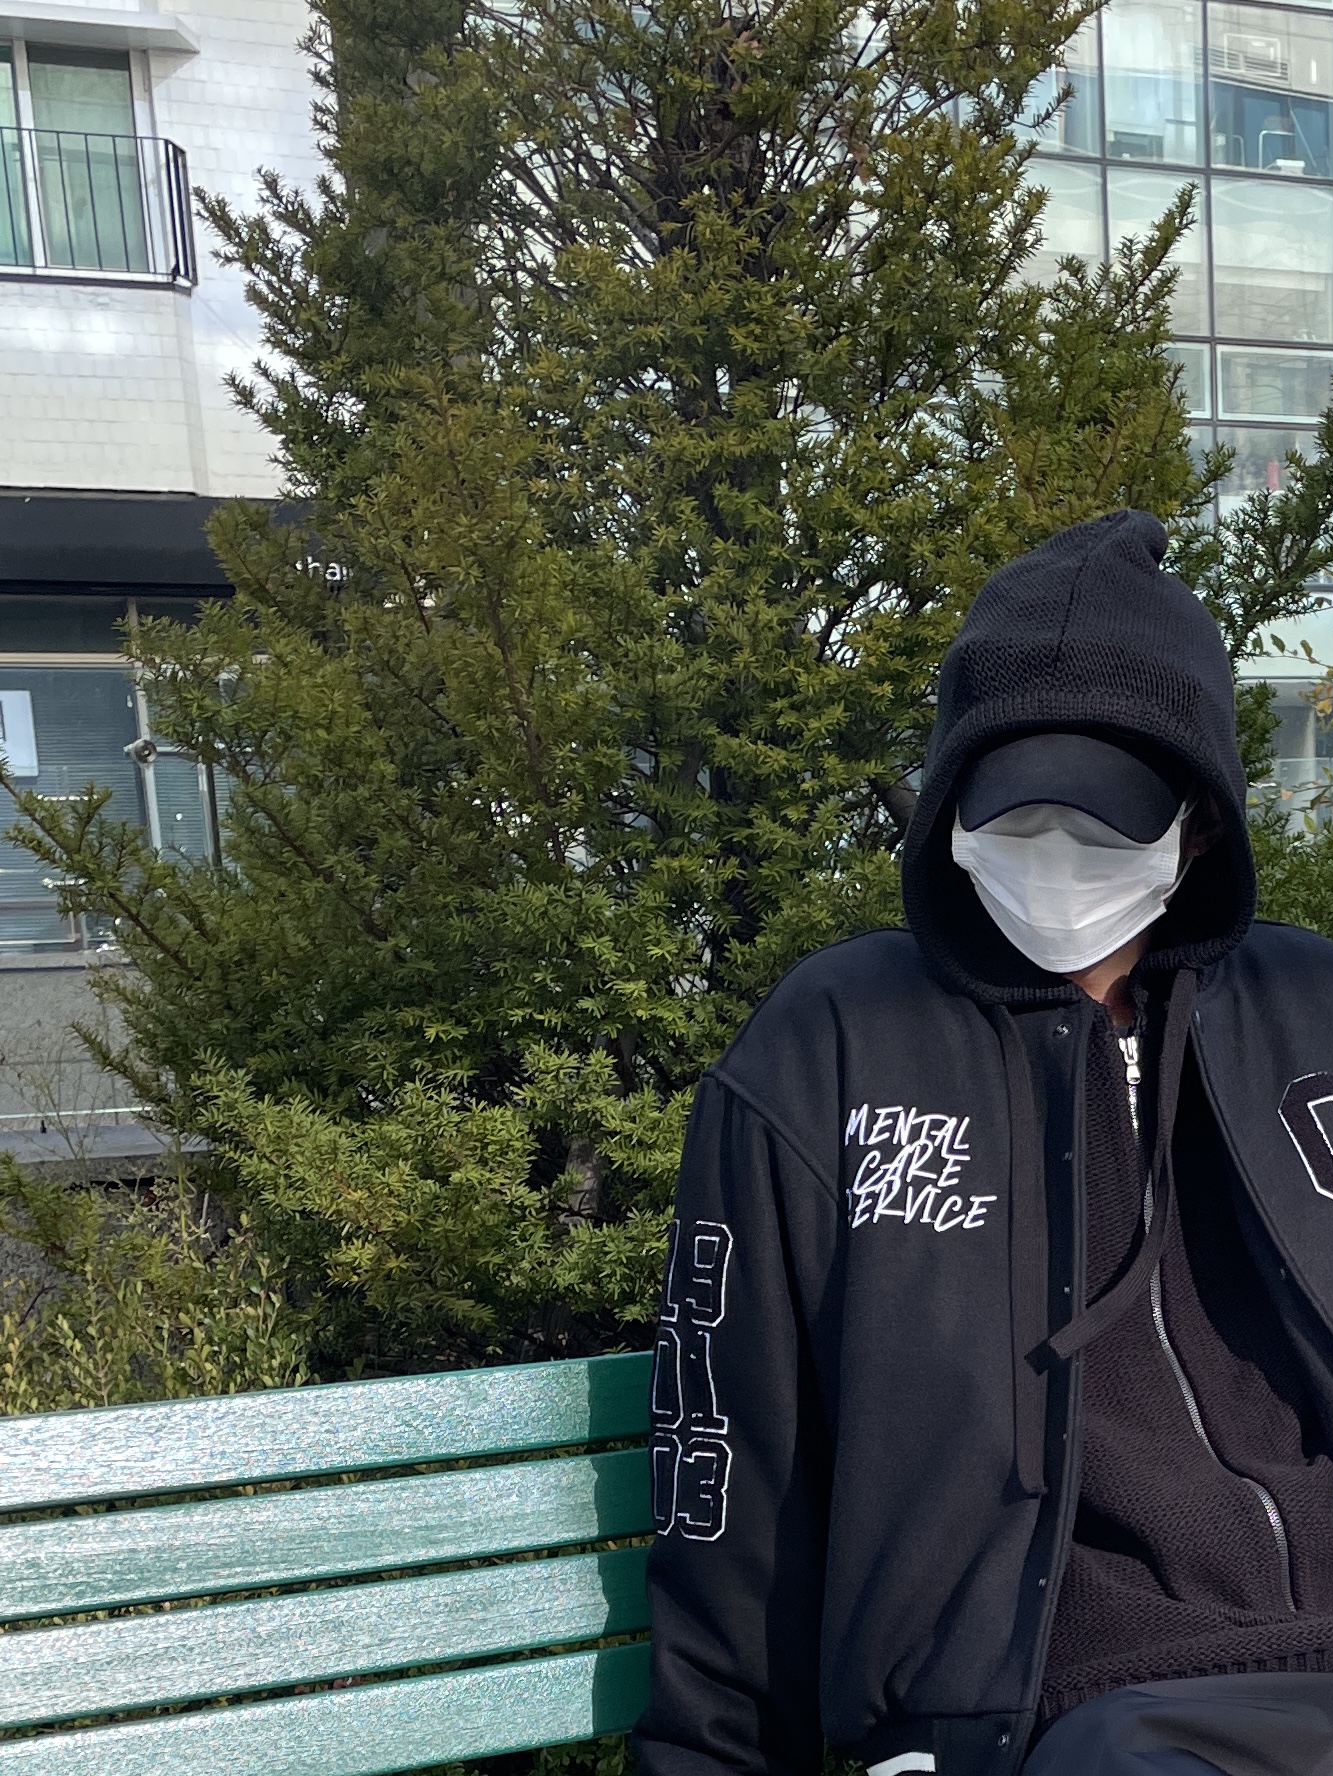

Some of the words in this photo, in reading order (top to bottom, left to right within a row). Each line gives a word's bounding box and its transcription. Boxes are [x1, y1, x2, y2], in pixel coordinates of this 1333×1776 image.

[844, 1103, 971, 1150] MENTAL
[852, 1139, 971, 1195] CARE
[845, 1177, 998, 1232] ERVICE
